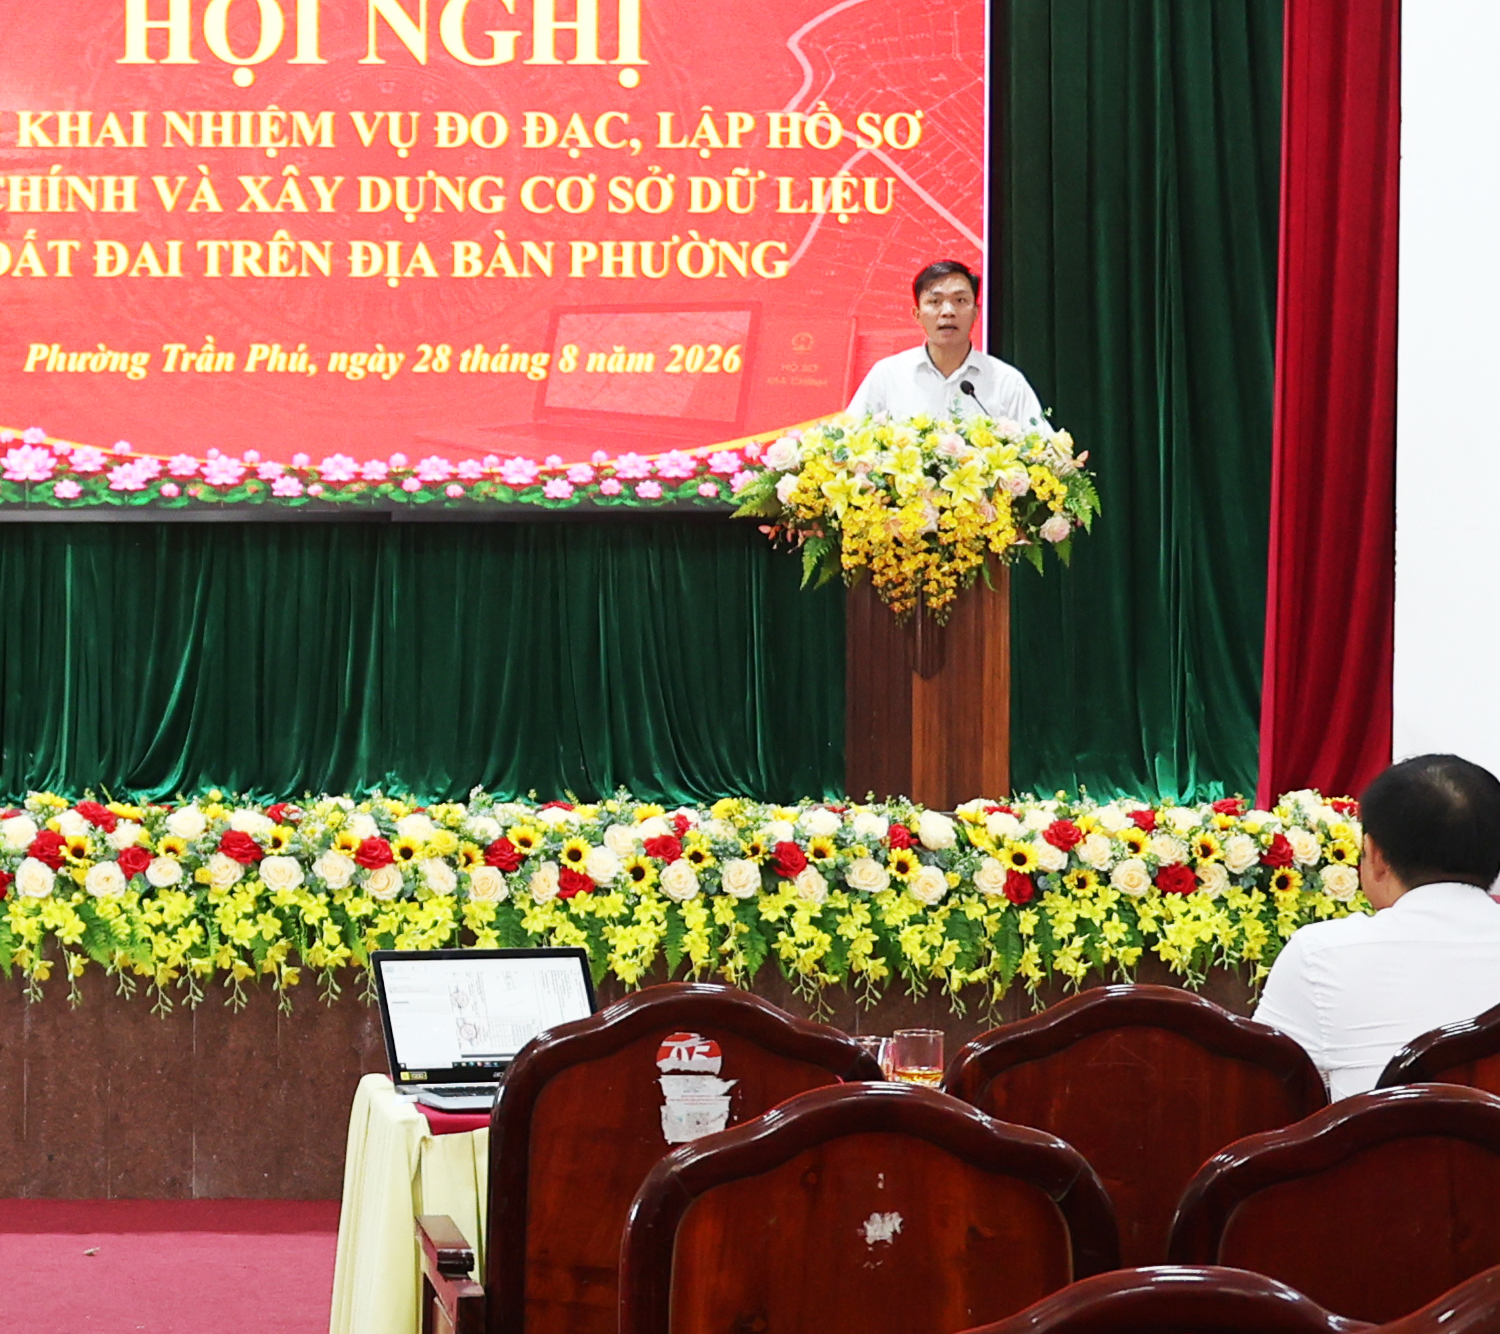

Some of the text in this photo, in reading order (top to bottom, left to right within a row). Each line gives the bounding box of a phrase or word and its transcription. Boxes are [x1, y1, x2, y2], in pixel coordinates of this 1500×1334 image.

[16, 111, 150, 148] KHAI
[162, 105, 336, 158] NHIỆM
[349, 111, 420, 158] VỤ
[434, 111, 508, 149] ĐO
[522, 111, 643, 159] ĐẠC,
[656, 106, 755, 159] LẬP
[766, 102, 846, 149] HỒ
[855, 109, 924, 149] SƠ
[153, 165, 222, 213] VÀ
[236, 165, 345, 213] XÂY
[357, 170, 504, 223] DỰNG
[520, 173, 596, 214] CƠ
[607, 166, 675, 214] SỞ
[688, 168, 767, 214] DỮ
[776, 170, 898, 224] LIỆU
[93, 240, 183, 277] ĐAI
[197, 230, 334, 277] TRÊN
[348, 240, 439, 287] ĐỊA
[450, 230, 554, 278] BÀN
[567, 230, 791, 278] PHƯỜNG
[24, 335, 742, 380] Phường Trần Phú, ngày 28 tháng 8 năm 2026
